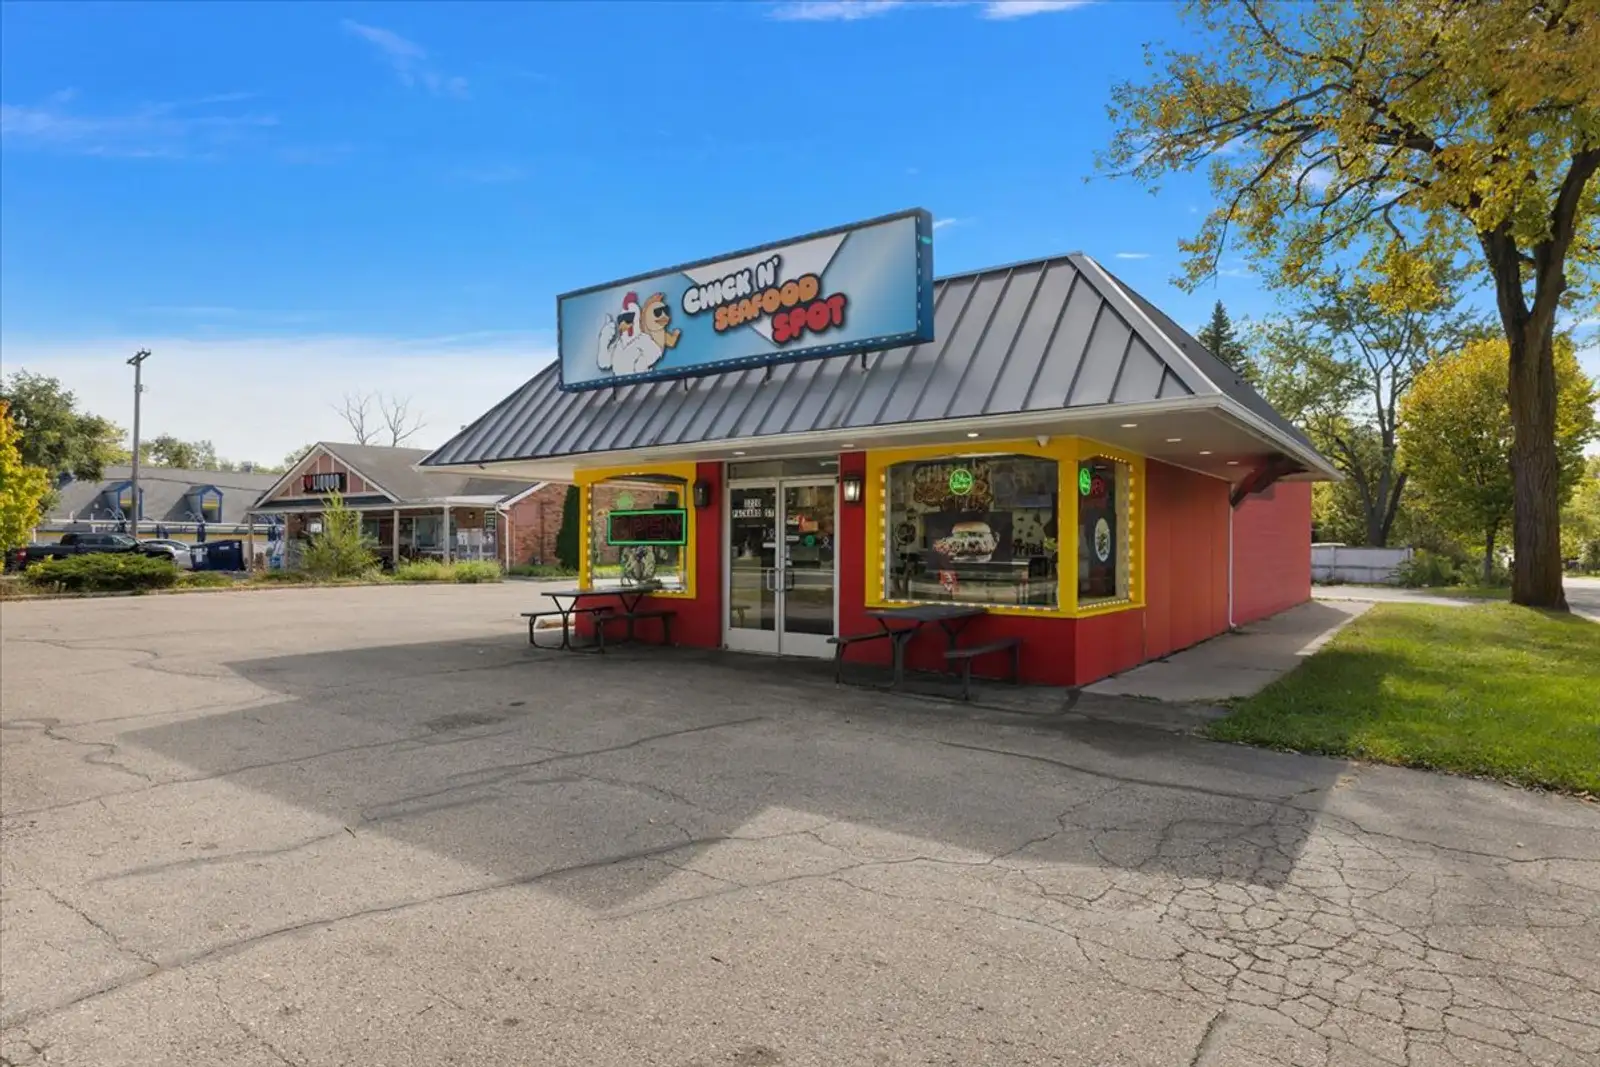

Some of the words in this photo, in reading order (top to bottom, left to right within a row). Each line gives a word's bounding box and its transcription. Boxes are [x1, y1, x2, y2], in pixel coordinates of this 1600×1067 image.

[683, 269, 751, 314] CHICK
[756, 254, 782, 289] N'
[714, 273, 820, 332] SEAFOOD
[772, 293, 847, 343] SPOT
[612, 515, 682, 540] OPEN
